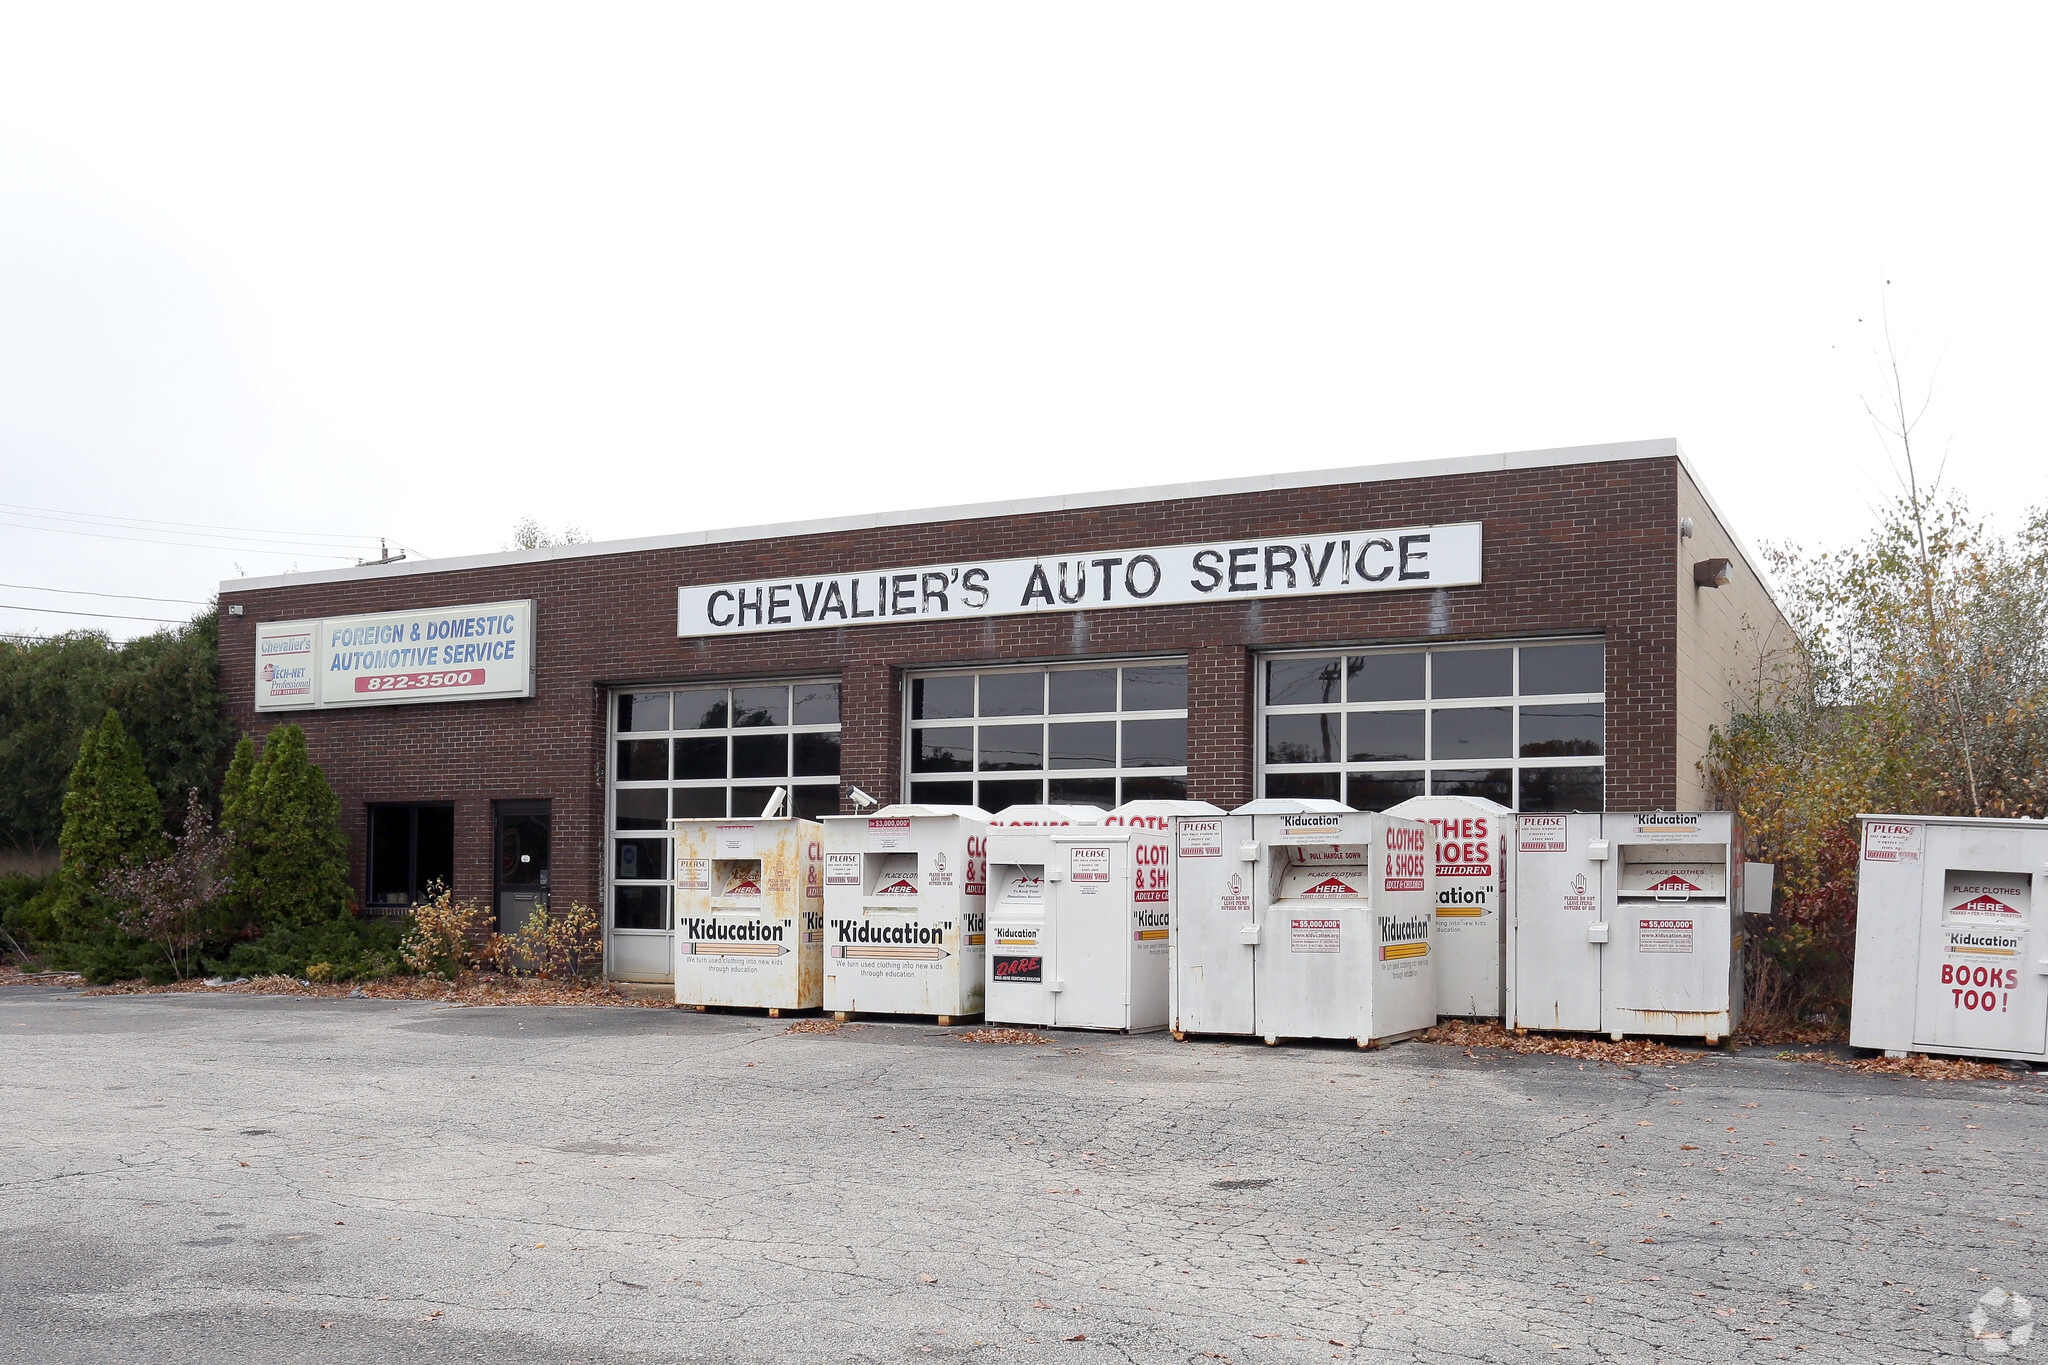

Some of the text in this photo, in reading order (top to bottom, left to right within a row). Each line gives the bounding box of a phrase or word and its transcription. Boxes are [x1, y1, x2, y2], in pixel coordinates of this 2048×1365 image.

[707, 534, 1431, 627] CHEVALIER'S AUTO SERVICE
[331, 614, 514, 648] FOREIGN & DOMESTIC
[262, 638, 311, 653] Chevalier's
[330, 640, 515, 672] AUTOMOTIVE SERVICE
[272, 678, 311, 690] Professional
[367, 672, 472, 690] 822-3500
[1184, 823, 1217, 831] PLEASE
[1280, 814, 1343, 826] "Kiducation"
[1634, 814, 1702, 825] "Kiducation"
[1386, 826, 1424, 852] CLOTHES
[967, 859, 975, 882] &
[1386, 853, 1424, 877] & SHOES
[808, 865, 816, 884] &
[1136, 869, 1145, 888] &
[1982, 887, 2020, 895] CLOTHES
[1967, 902, 2004, 911] HERE
[680, 918, 791, 941] "Kiducation"
[830, 919, 952, 944] "Kiducation"
[994, 928, 1040, 938] "Kiducation"
[1378, 914, 1431, 942] "Kiducation"
[1945, 933, 2023, 947] "Kiducation"
[722, 958, 745, 966] clothing
[877, 962, 900, 970] clothing
[861, 970, 884, 978] through
[1942, 964, 2018, 989] BOOKS
